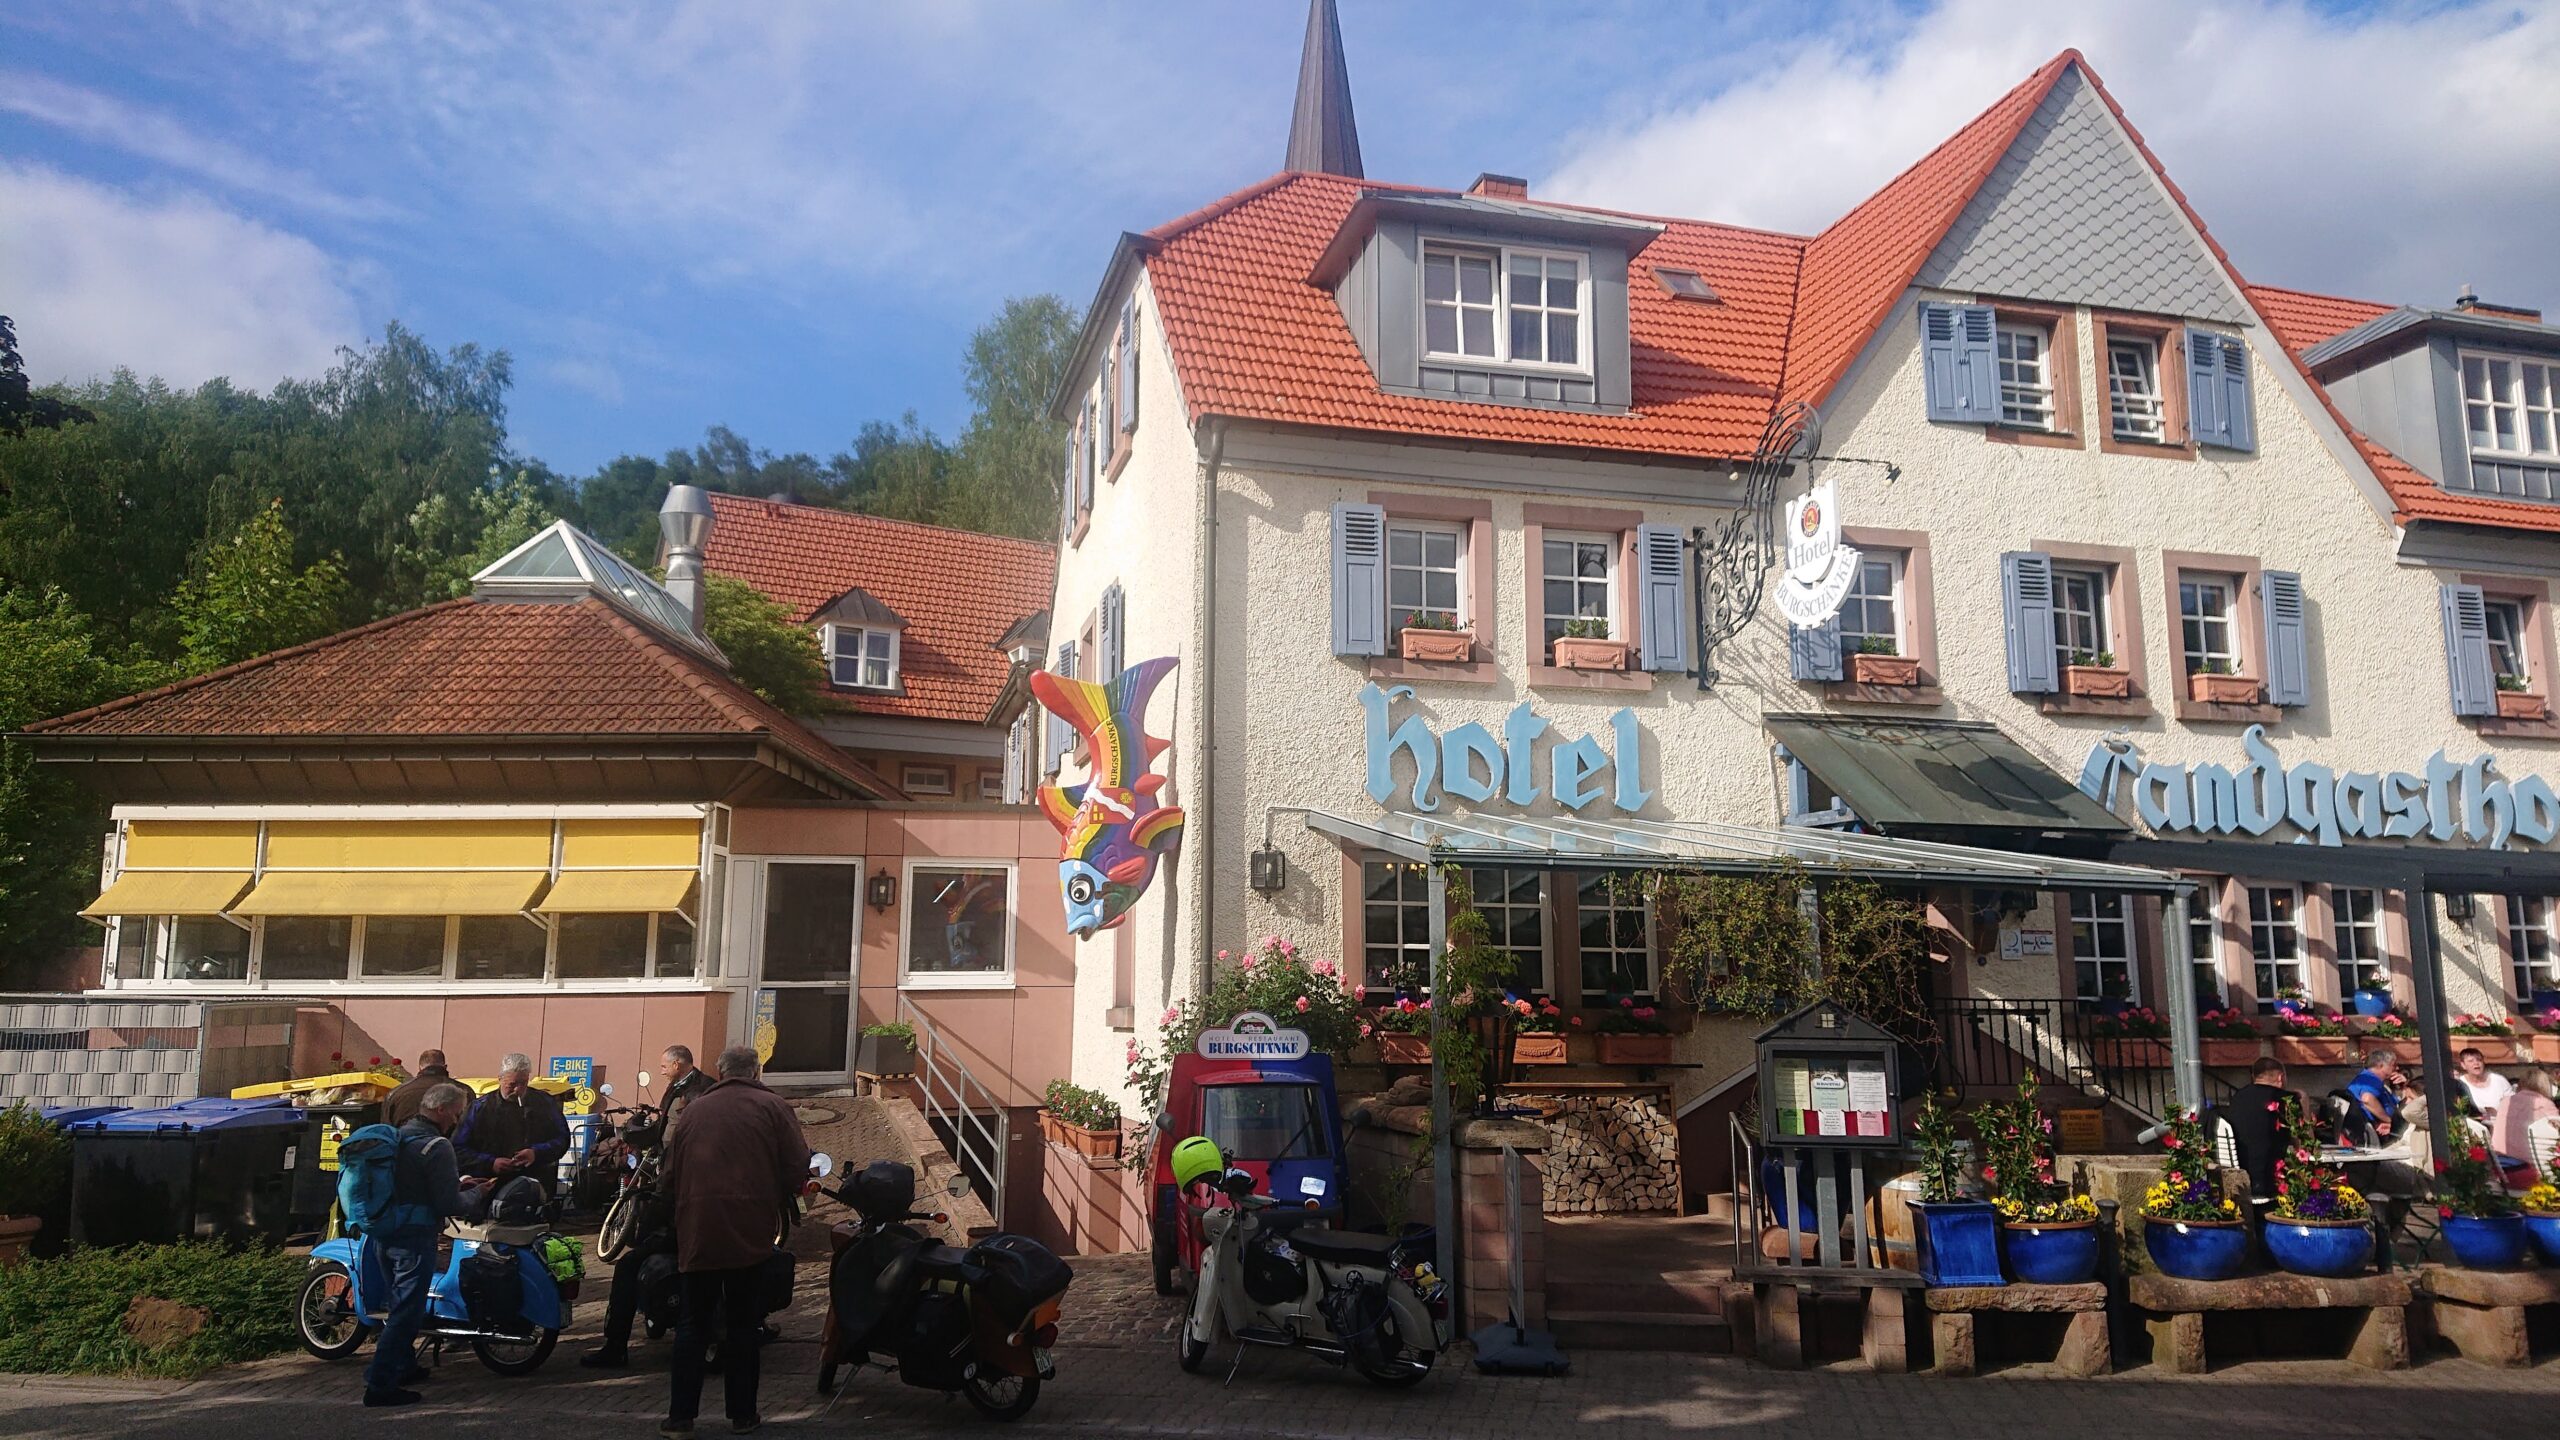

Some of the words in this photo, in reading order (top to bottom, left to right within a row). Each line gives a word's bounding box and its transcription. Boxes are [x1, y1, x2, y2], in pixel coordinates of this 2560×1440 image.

[1793, 531, 1831, 569] Hotel
[1777, 554, 1853, 617] BURGSCHÄNKE
[553, 1059, 588, 1070] E-BIKE
